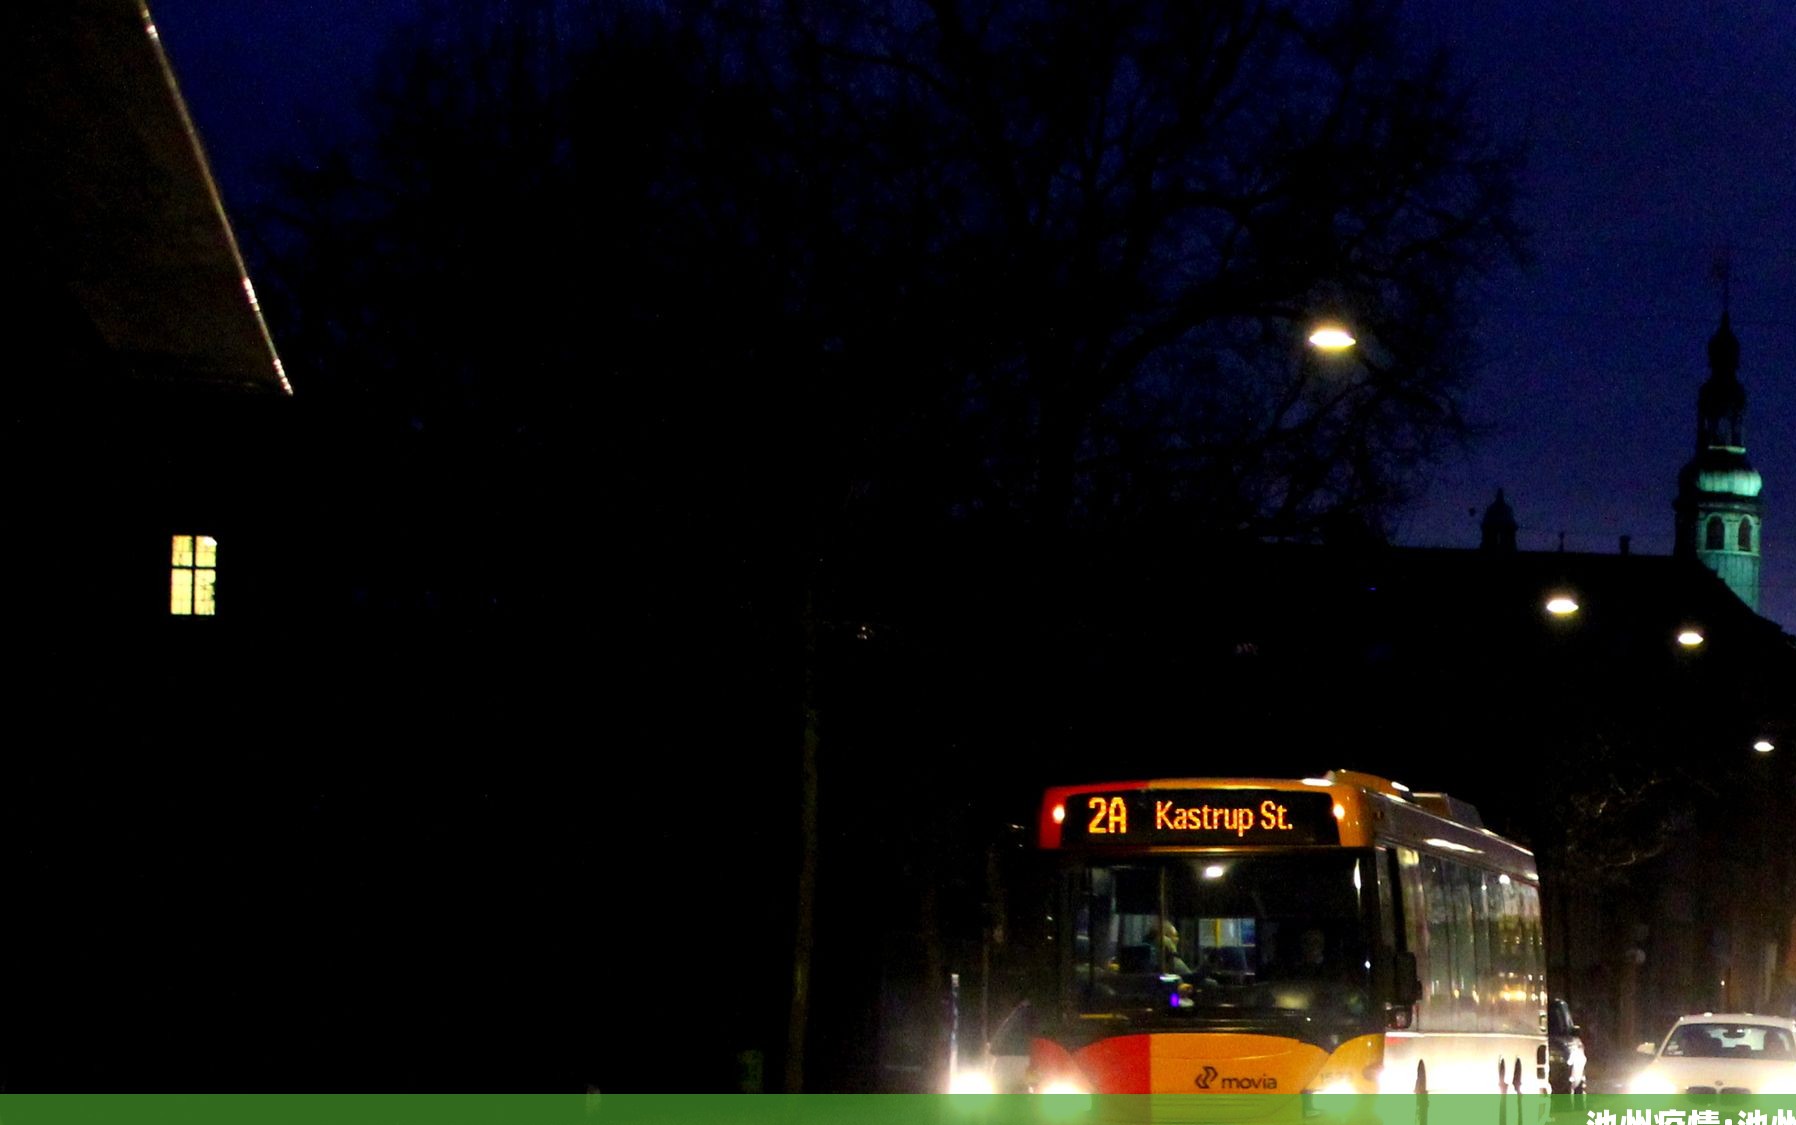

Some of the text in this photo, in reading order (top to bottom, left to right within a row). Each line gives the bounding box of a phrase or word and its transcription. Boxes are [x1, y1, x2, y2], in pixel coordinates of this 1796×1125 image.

[1088, 797, 1293, 837] 2A Kastrup St.
[1221, 1073, 1278, 1090] movia
